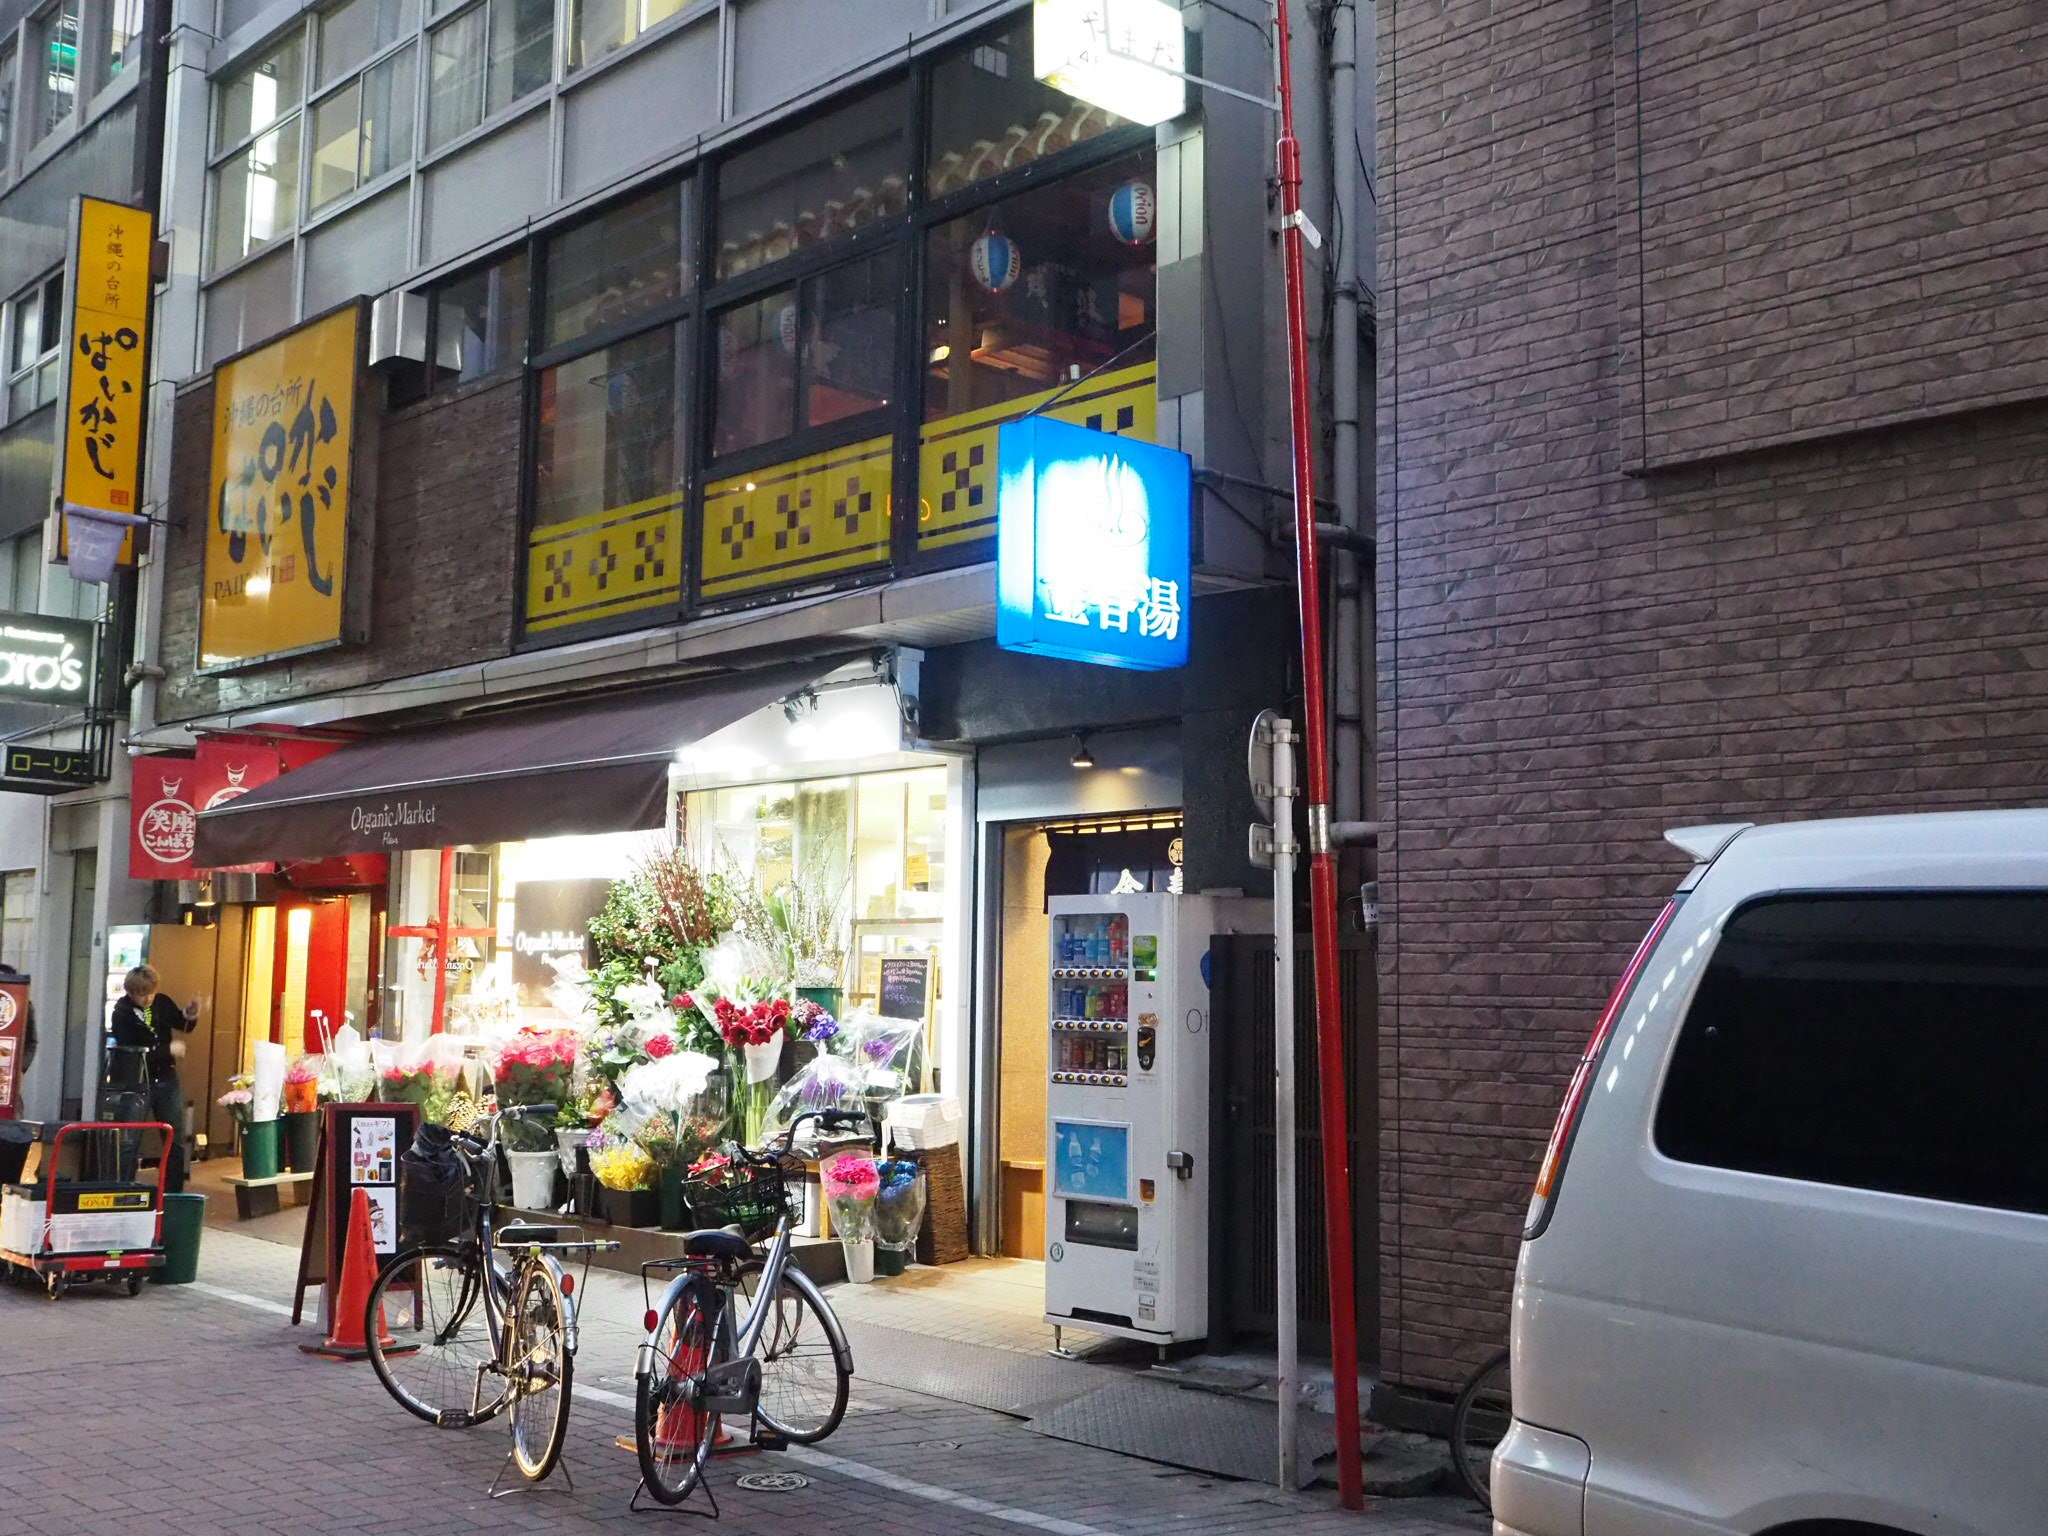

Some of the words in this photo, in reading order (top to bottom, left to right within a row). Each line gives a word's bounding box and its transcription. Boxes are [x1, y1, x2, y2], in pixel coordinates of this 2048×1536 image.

[79, 327, 138, 480] ぱいかじ
[351, 804, 395, 835] Organic
[395, 800, 437, 827] Market
